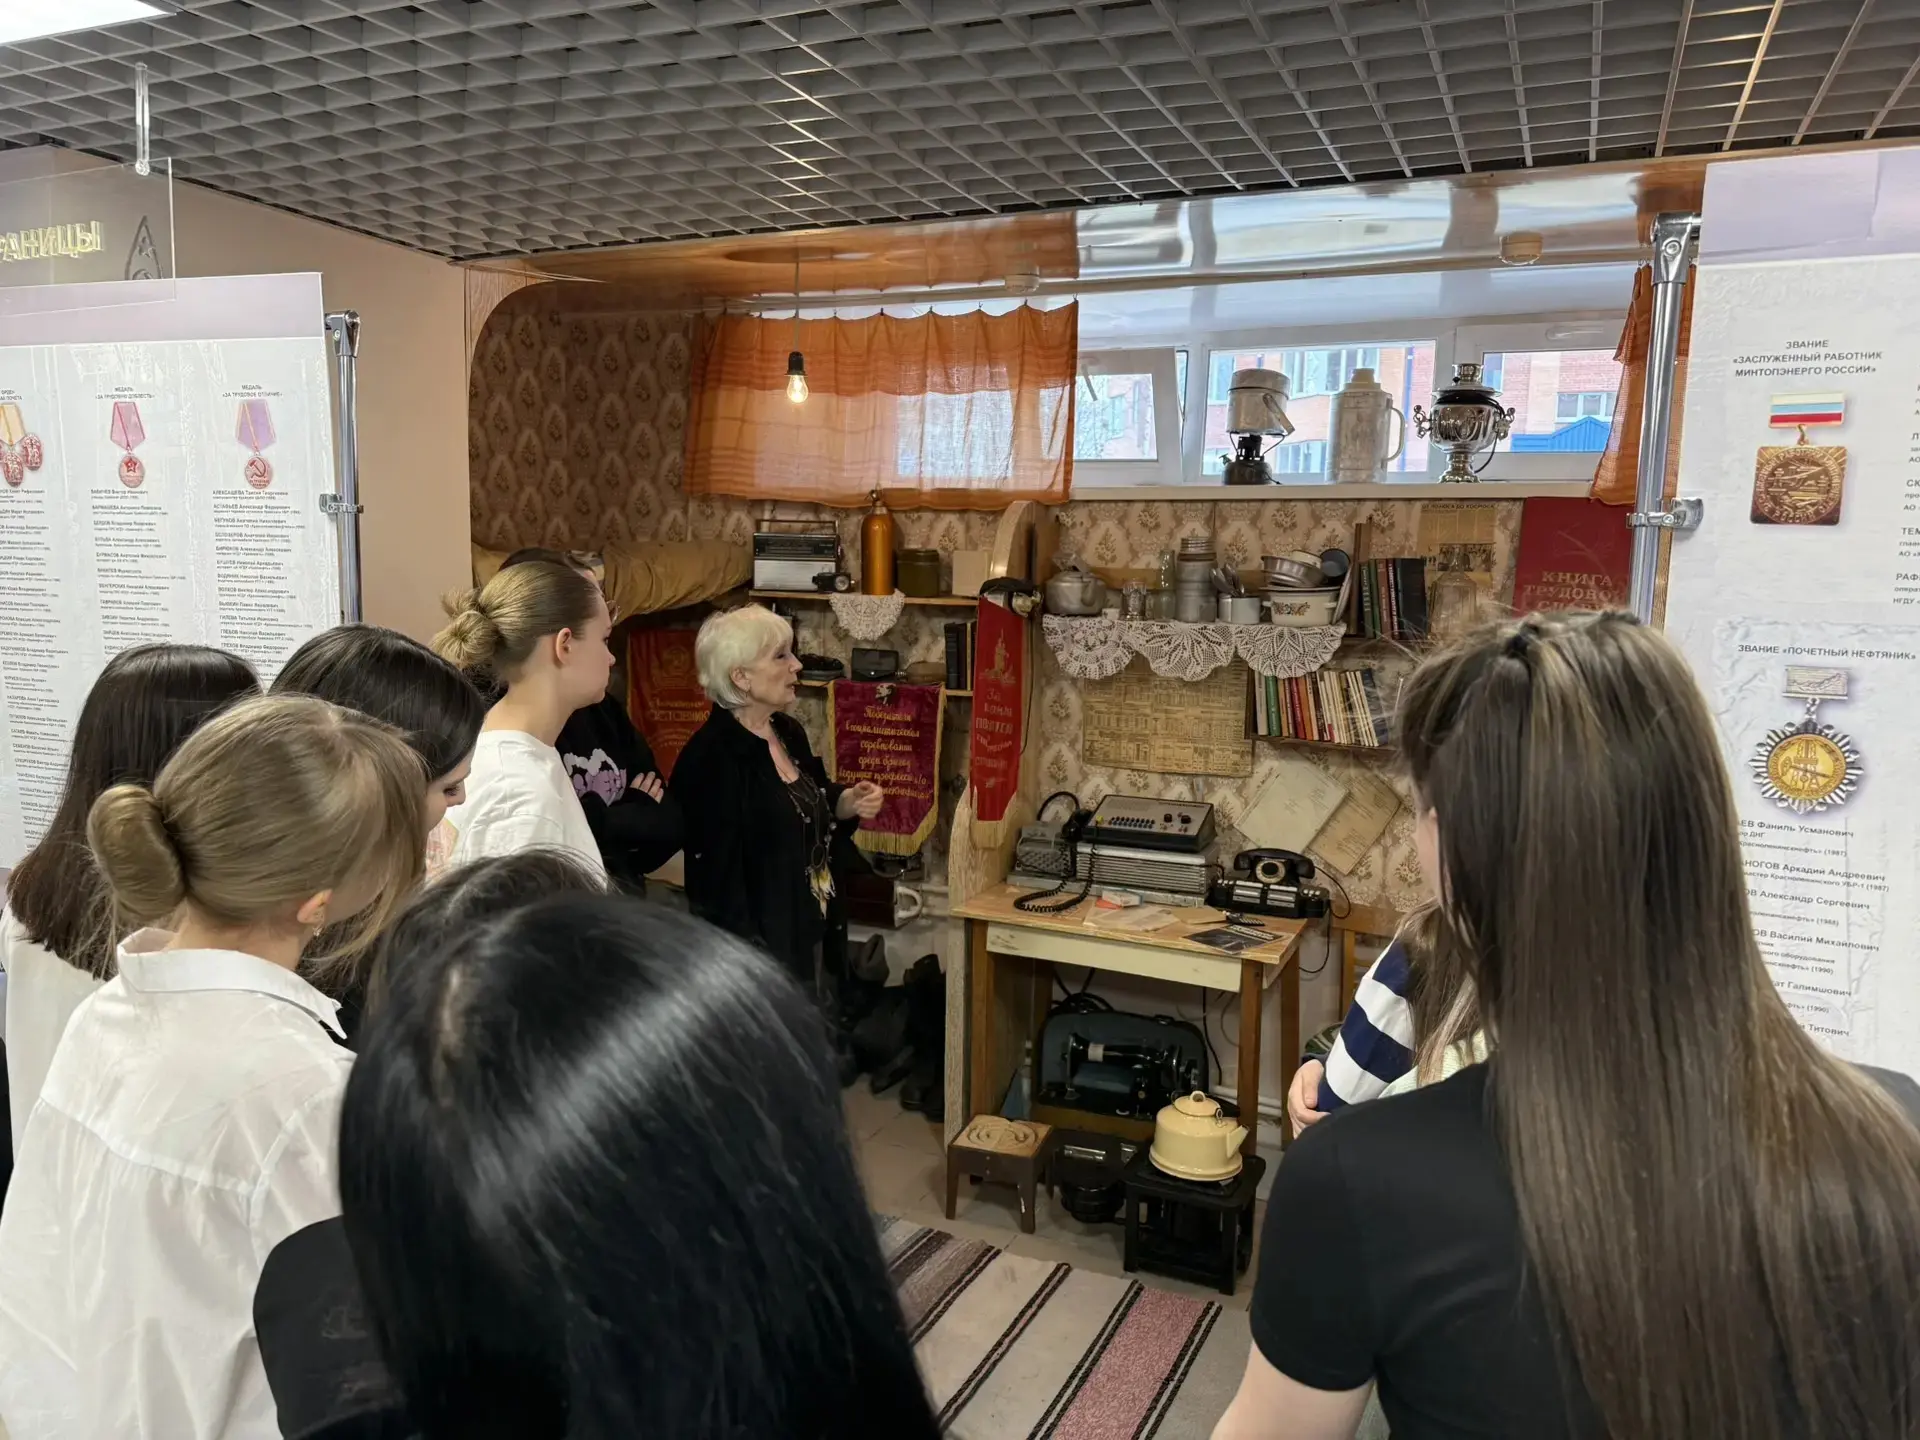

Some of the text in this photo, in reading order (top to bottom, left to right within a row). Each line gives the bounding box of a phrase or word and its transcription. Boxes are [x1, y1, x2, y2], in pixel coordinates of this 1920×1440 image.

[1785, 340, 1829, 349] ЗВАНИЕ
[1733, 351, 1882, 364] «ЗАСЛУЖЕННЫЙ РАБОТНИК
[1735, 365, 1876, 377] МИНТОПЭНЕРГО РОССИИ»
[1541, 570, 1613, 586] КНИГА
[1896, 573, 1920, 581] РАФ
[1738, 644, 1917, 660] ЗВАНИЕ «ПОЧЕТНЫЙ НЕФТЯНИК»
[1739, 819, 1854, 838] ЕВ Фаниль Усманович
[1742, 860, 1886, 882] НОГОВ Аркадий Андреевич
[1866, 884, 1890, 893] (1987)
[1744, 889, 1870, 910] ОВ Александр Сергеевич
[1752, 928, 1880, 952] ОВ Василий Михайлович
[1808, 1023, 1850, 1037] Титович
